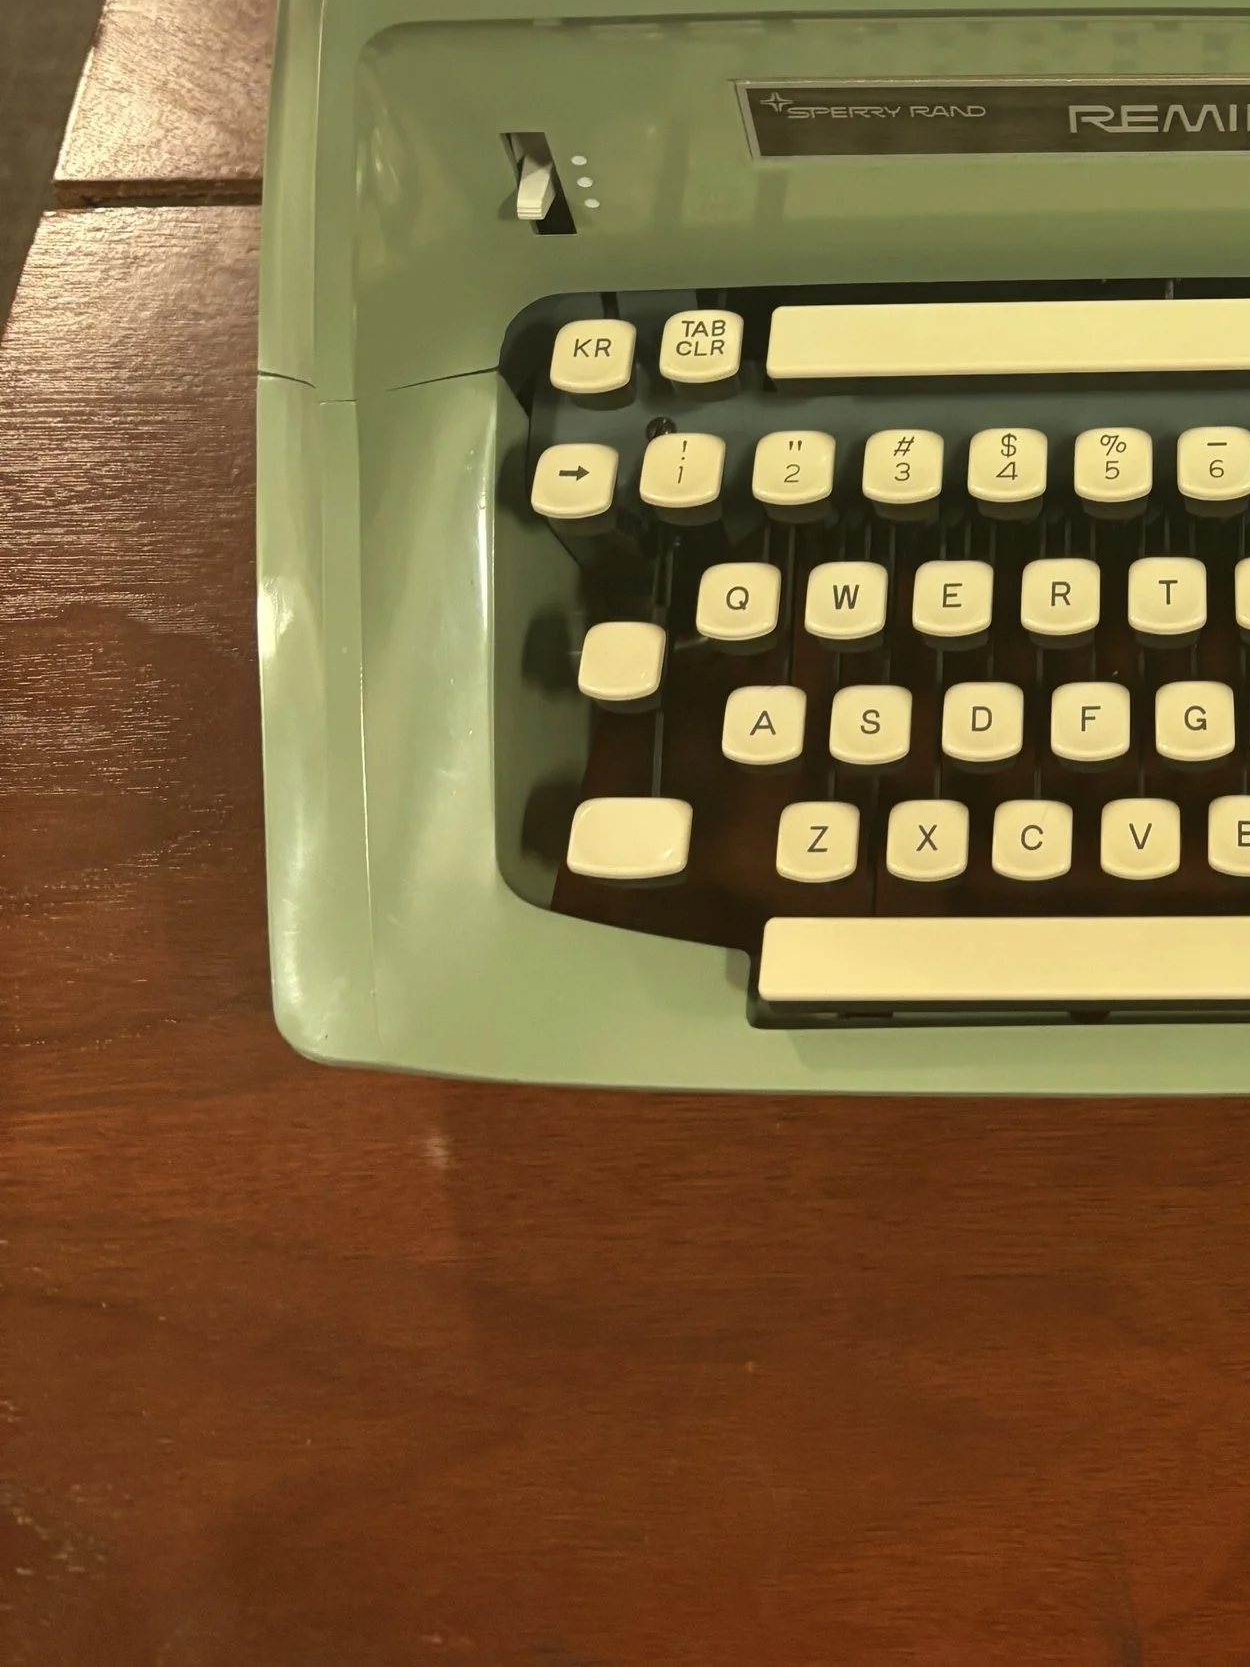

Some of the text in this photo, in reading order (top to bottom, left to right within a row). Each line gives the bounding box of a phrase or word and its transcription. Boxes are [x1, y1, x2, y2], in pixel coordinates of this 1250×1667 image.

[786, 105, 986, 119] SPERRY RAND
[680, 319, 727, 338] TAB
[573, 338, 612, 358] KR
[675, 339, 725, 358] CLR
[1000, 432, 1018, 458] $
[1099, 434, 1127, 457] %
[783, 463, 801, 483] 2
[894, 462, 911, 482] 3
[995, 461, 1018, 481] 4
[1104, 460, 1120, 480] 5
[1209, 459, 1225, 479] 6
[726, 586, 750, 611] Q
[832, 584, 860, 610] W
[942, 582, 963, 608] E
[1050, 581, 1071, 607] R
[1158, 579, 1179, 605] T
[749, 710, 777, 736] A
[860, 709, 881, 735] S
[971, 705, 993, 732] D
[1081, 705, 1102, 732] F
[1184, 705, 1207, 731] G
[806, 825, 829, 853] Z
[916, 824, 938, 852] X
[1020, 824, 1044, 851] C
[1128, 822, 1153, 850] V
